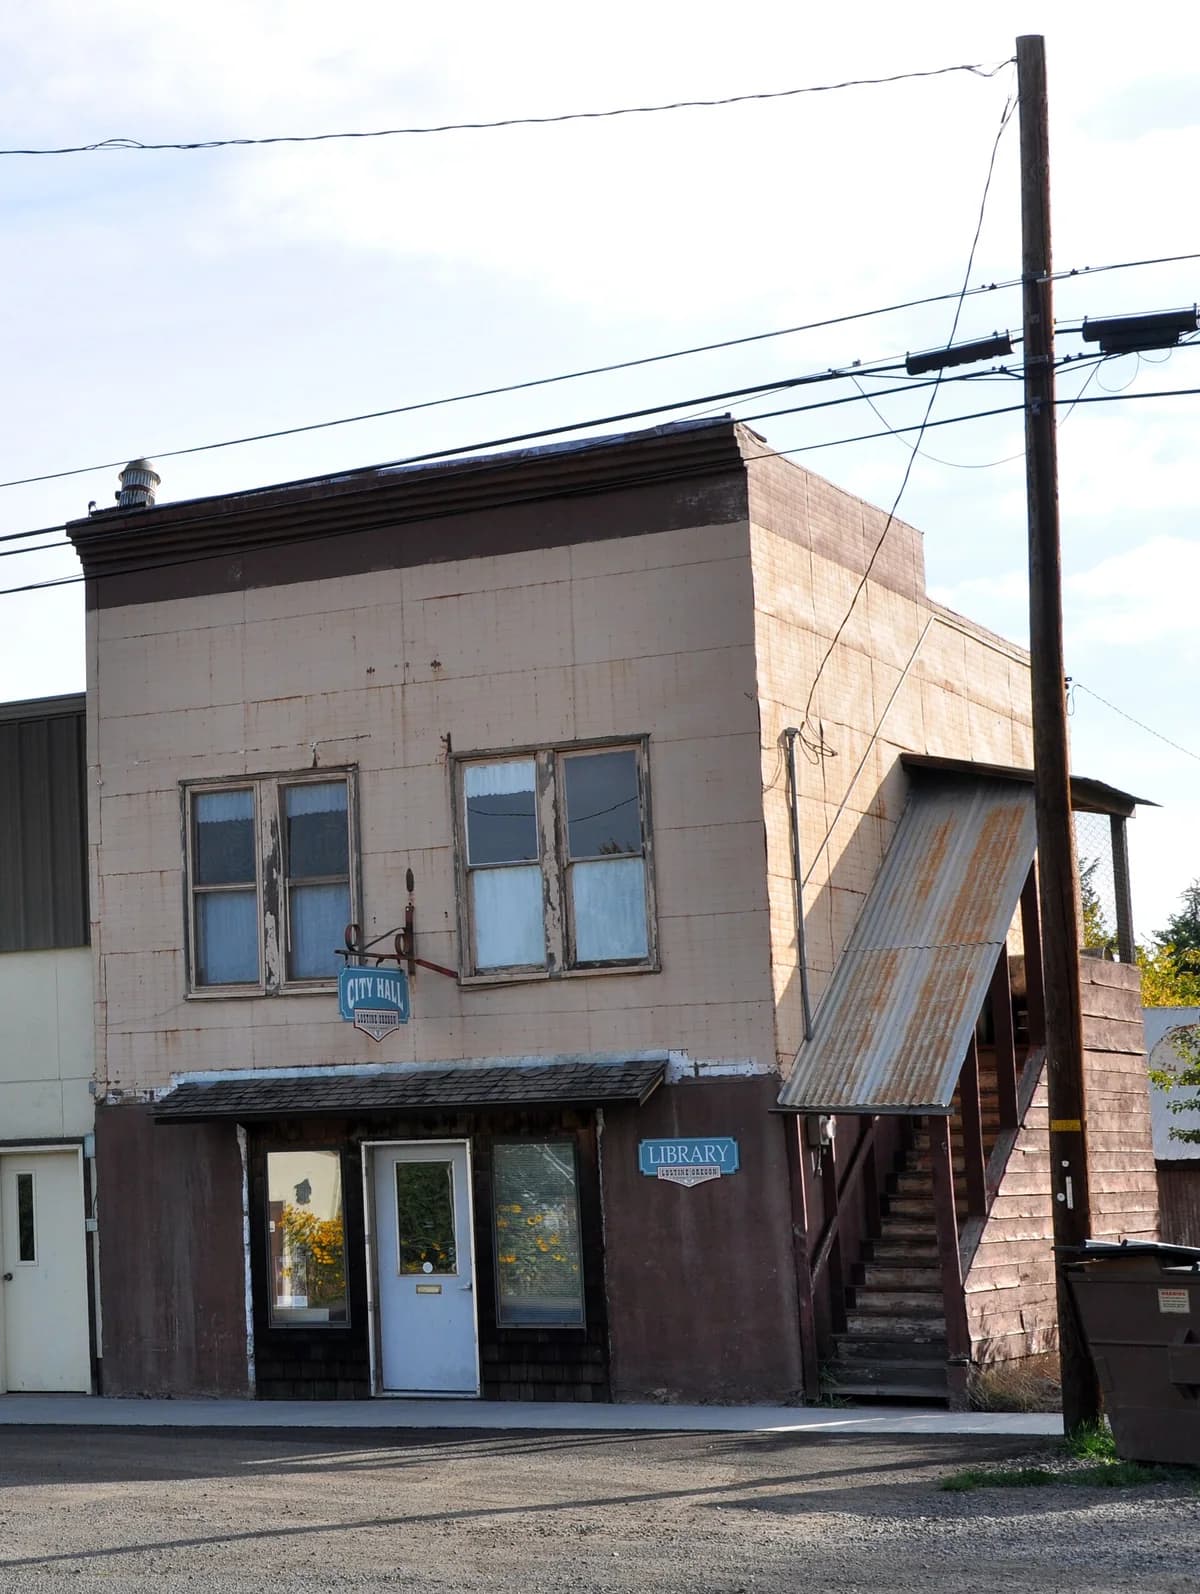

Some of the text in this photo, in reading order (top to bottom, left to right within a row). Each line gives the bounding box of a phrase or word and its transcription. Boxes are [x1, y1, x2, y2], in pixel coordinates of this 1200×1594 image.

[347, 977, 404, 1011] CITY HALL
[648, 1145, 728, 1163] LIBRARY
[661, 1168, 717, 1176] LOSTINE OREGON
